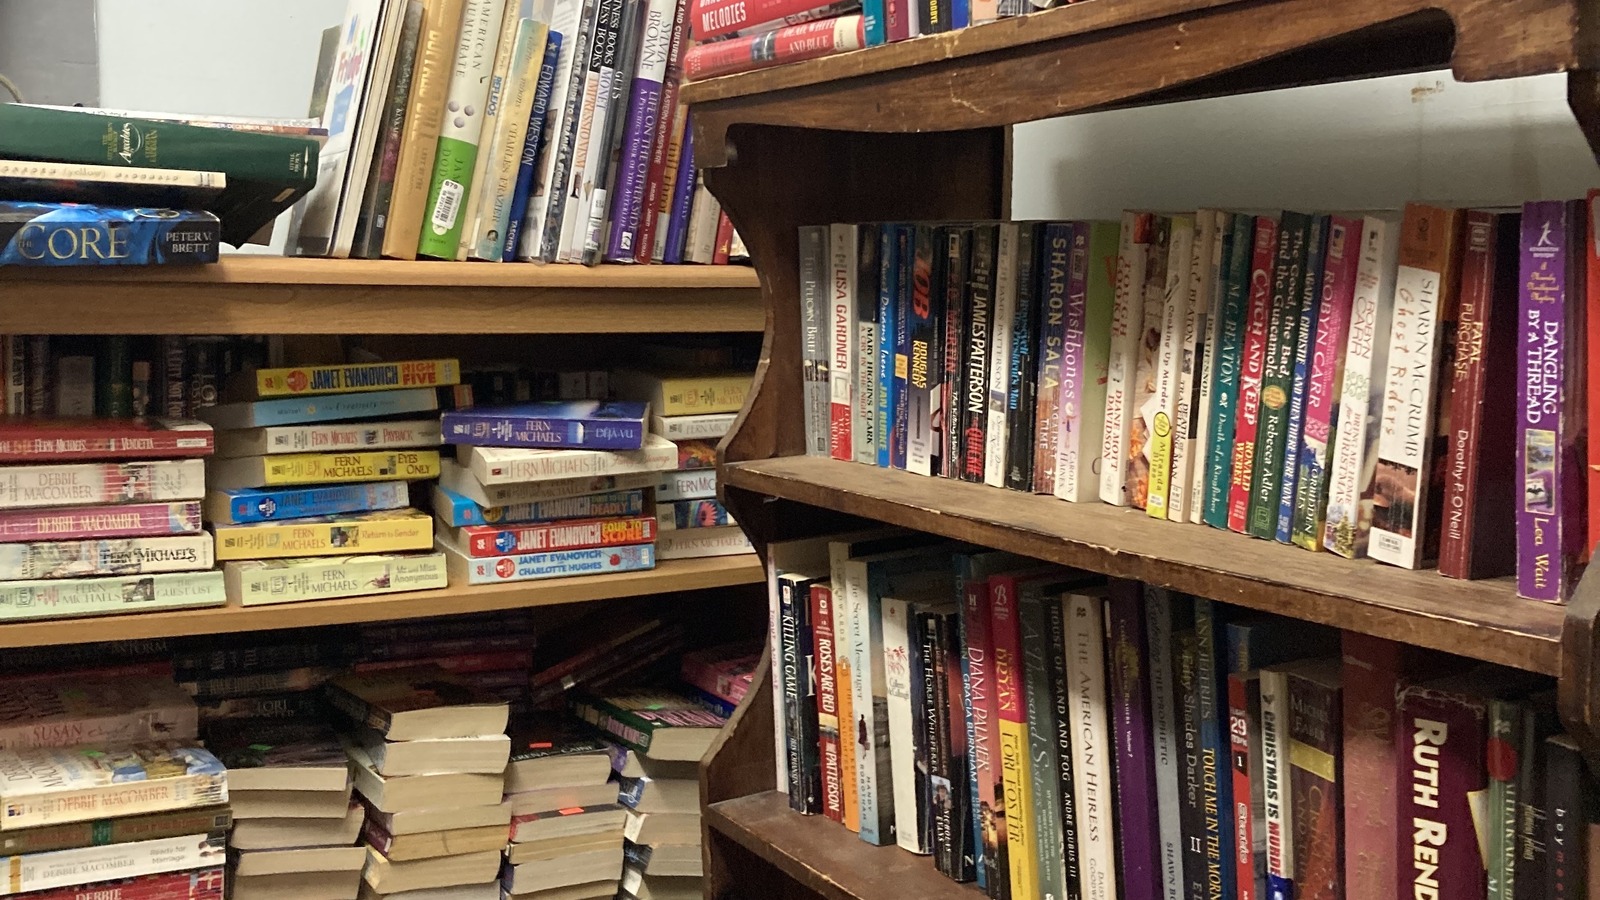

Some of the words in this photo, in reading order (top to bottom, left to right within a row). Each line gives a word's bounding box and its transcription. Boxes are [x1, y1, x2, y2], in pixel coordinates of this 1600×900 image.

[677, 8, 685, 24] AND
[702, 4, 747, 32] MELODIES
[591, 27, 607, 68] BOOKS
[603, 31, 617, 65] BOOKS
[641, 10, 661, 70] BROWNE
[656, 21, 671, 63] SYLVIA
[670, 26, 682, 63] CULTURES
[533, 64, 554, 115] EDWARD
[596, 70, 612, 110] MONET
[646, 90, 659, 113] LIFE
[522, 117, 543, 166] WESTON
[574, 78, 600, 169] IMPRESSIONISM
[643, 115, 655, 138] ON
[653, 114, 668, 165] HEMISPHERE
[502, 122, 518, 173] CHARLES
[639, 139, 652, 162] THE
[20, 224, 130, 259] CORE
[166, 232, 202, 242] PETER
[173, 244, 208, 253] BRETT
[505, 220, 518, 253] TASCHEN
[1279, 230, 1290, 260] and
[835, 270, 847, 300] LISA
[1048, 238, 1067, 327] SHARON
[1275, 264, 1289, 289] the
[971, 293, 987, 340] JAMES
[1119, 261, 1131, 337] TOUGH
[1185, 289, 1198, 345] BEATON
[1252, 268, 1268, 337] CATCH
[1316, 271, 1335, 346] ROBYN
[1164, 304, 1175, 347] Cooking
[1284, 315, 1295, 340] the
[1350, 296, 1367, 357] CARR
[1361, 301, 1376, 361] ROBYN
[1394, 289, 1415, 354] Ghost
[1415, 278, 1433, 357] SHARYN
[1528, 309, 1541, 330] BY
[835, 304, 847, 370] GARDNER
[866, 327, 874, 356] MARY
[1063, 292, 1085, 400] Wishbones
[1219, 319, 1237, 387] BEATON
[1295, 315, 1310, 365] CHRISTIE
[1455, 302, 1474, 381] PURCHASE
[1469, 320, 1485, 365] FATAL
[1527, 332, 1541, 343] A
[401, 361, 437, 374] HIGH
[912, 340, 922, 388] KENNEDY
[918, 341, 928, 390] DOUGLAS
[1044, 335, 1062, 390] SALA
[1163, 352, 1171, 367] Up
[1247, 338, 1262, 374] AND
[1278, 345, 1291, 379] Bad,
[1543, 321, 1560, 415] DANGLING
[310, 370, 341, 390] JANET
[344, 365, 399, 388] EVANOVICH
[402, 373, 437, 386] FIVE
[866, 360, 874, 406] HIGGINS
[968, 340, 986, 415] PATTERSON
[1160, 370, 1170, 410] Murder
[1293, 374, 1303, 395] AND
[1309, 352, 1326, 408] CARR
[1526, 346, 1543, 424] THREAD
[1112, 390, 1123, 429] DIANE
[1242, 374, 1260, 426] KEEP
[1290, 396, 1301, 421] THEN
[1384, 366, 1408, 435] Riders
[311, 432, 329, 448] FERN
[383, 428, 414, 442] PAYBACK
[515, 431, 562, 443] MICHAELS
[525, 419, 553, 432] FERN
[866, 409, 874, 445] CLARK
[1039, 419, 1050, 450] TIME
[1050, 405, 1060, 461] AGAINST
[1103, 394, 1115, 460] DAVIDSON
[1263, 415, 1278, 465] Rebecca
[1287, 422, 1299, 450] THERE
[334, 456, 362, 467] FERN
[398, 454, 419, 464] EYES
[540, 456, 591, 475] MICHAELS
[1110, 431, 1120, 471] MOTT
[1156, 441, 1167, 492] Miranda
[1232, 442, 1245, 486] WEBER
[1242, 440, 1255, 492] RONALD
[1284, 450, 1296, 480] WERE
[1335, 421, 1352, 505] CHRISTMAS
[1452, 430, 1469, 481] Dorothy
[39, 472, 79, 488] DEBBIE
[323, 466, 374, 479] MICHAELS
[406, 464, 431, 475] ONLY
[677, 479, 698, 495] FERN
[1259, 467, 1273, 502] Adler
[23, 485, 94, 501] MACOMBER
[1281, 479, 1293, 507] NONE
[1304, 461, 1319, 535] FORBIDDEN
[37, 516, 75, 534] DEBBIE
[80, 513, 141, 532] MACOMBER
[293, 529, 315, 540] FERN
[602, 521, 628, 533] FOUR
[630, 519, 642, 530] TO
[1450, 496, 1464, 540] O'Neill
[1534, 517, 1550, 547] Lea
[282, 539, 326, 551] MICHAELS
[517, 529, 547, 551] JANET
[549, 523, 601, 548] EVANOVICH
[602, 529, 643, 544] SCORE
[322, 569, 346, 581] FERN
[518, 564, 567, 577] CHARLOTTE
[569, 562, 603, 573] HUGHES
[519, 554, 548, 566] JANET
[550, 549, 602, 563] EVANOVICH
[1535, 553, 1550, 589] Wait
[311, 579, 359, 594] MICHAELS
[782, 615, 796, 664] KILLING
[1051, 604, 1061, 649] HOUSE
[819, 638, 833, 674] ROSES
[923, 644, 932, 664] THE
[1078, 632, 1089, 664] THE
[784, 664, 798, 702] GAME
[820, 673, 834, 694] ARE
[924, 667, 934, 707] HORSE
[968, 647, 986, 702] DIANA
[821, 692, 836, 713] RED
[963, 673, 973, 719] GRACIA
[1056, 678, 1067, 715] SAND
[33, 723, 81, 740] SUSAN
[1058, 719, 1069, 750] AND
[1080, 669, 1095, 768] AMERICAN
[1184, 694, 1200, 750] Shades
[927, 708, 939, 774] WHISPERER
[966, 722, 978, 783] BURNHAM
[972, 705, 991, 774] PALMER
[1262, 710, 1277, 801] CHRISTMAS
[1060, 753, 1071, 782] FOG
[1185, 754, 1201, 809] Darker
[1202, 747, 1216, 794] TOUCH
[1412, 717, 1449, 810] RUTH
[57, 794, 98, 812] DEBBIE
[101, 786, 170, 806] MACOMBER
[825, 752, 840, 812] PATTERSON
[1064, 791, 1074, 827] ANDRE
[1086, 771, 1100, 843] HEIRESS
[1204, 794, 1218, 816] ME
[1266, 802, 1279, 821] IS
[1206, 817, 1219, 833] IN
[1067, 829, 1077, 863] DUBUS
[1165, 841, 1176, 886] SHAWN
[1207, 834, 1220, 861] THE
